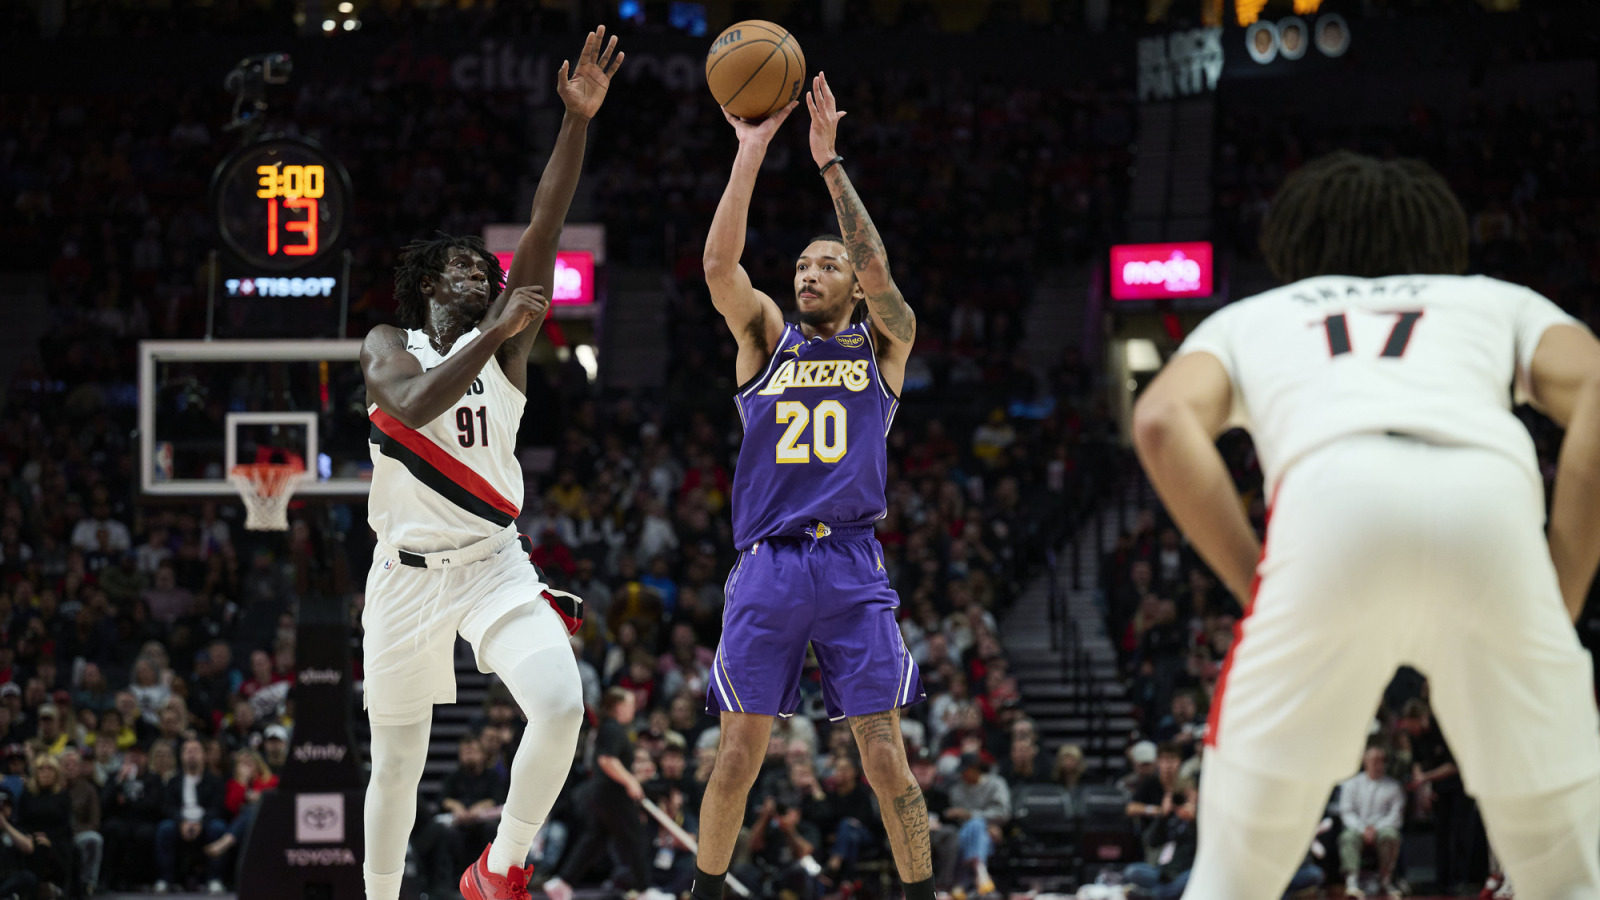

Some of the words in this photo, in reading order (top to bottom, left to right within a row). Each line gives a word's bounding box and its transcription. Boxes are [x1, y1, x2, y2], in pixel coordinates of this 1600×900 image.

[451, 39, 548, 104] city
[256, 165, 325, 199] 3:00
[267, 198, 318, 256] 13
[254, 277, 336, 297] TISSOT
[1307, 305, 1425, 358] 17
[757, 358, 870, 395] LAKERS
[456, 406, 488, 448] 91
[776, 400, 847, 464] 20
[293, 742, 348, 763] xfinity
[285, 848, 356, 866] TOYOTA
